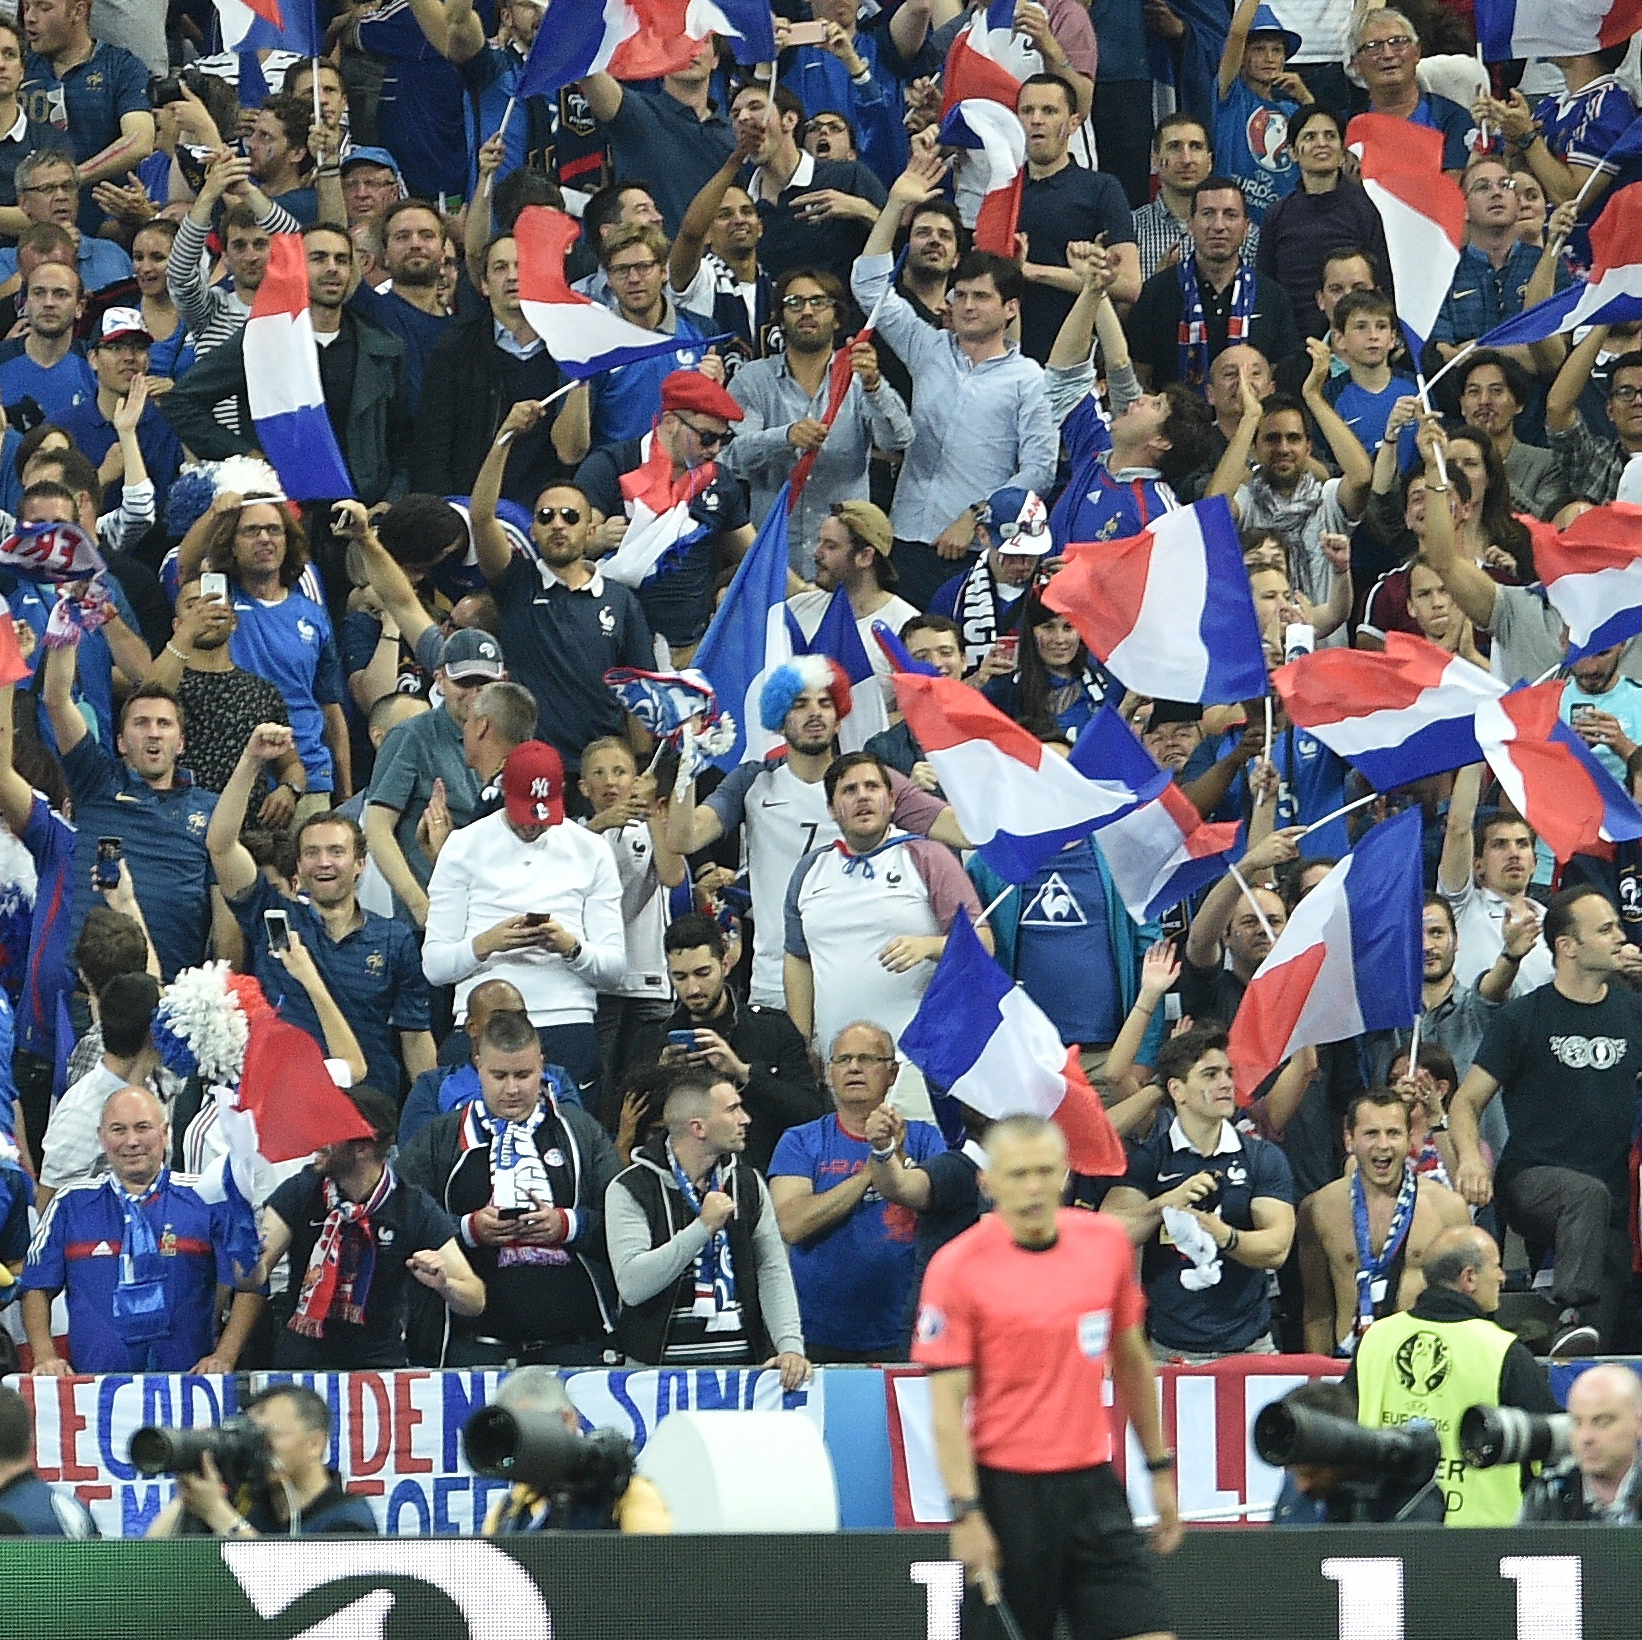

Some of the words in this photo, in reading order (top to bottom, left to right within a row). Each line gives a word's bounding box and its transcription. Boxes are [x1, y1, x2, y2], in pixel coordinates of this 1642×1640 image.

[800, 822, 820, 858] 7
[19, 1374, 99, 1482] LE
[348, 1371, 434, 1477] DE
